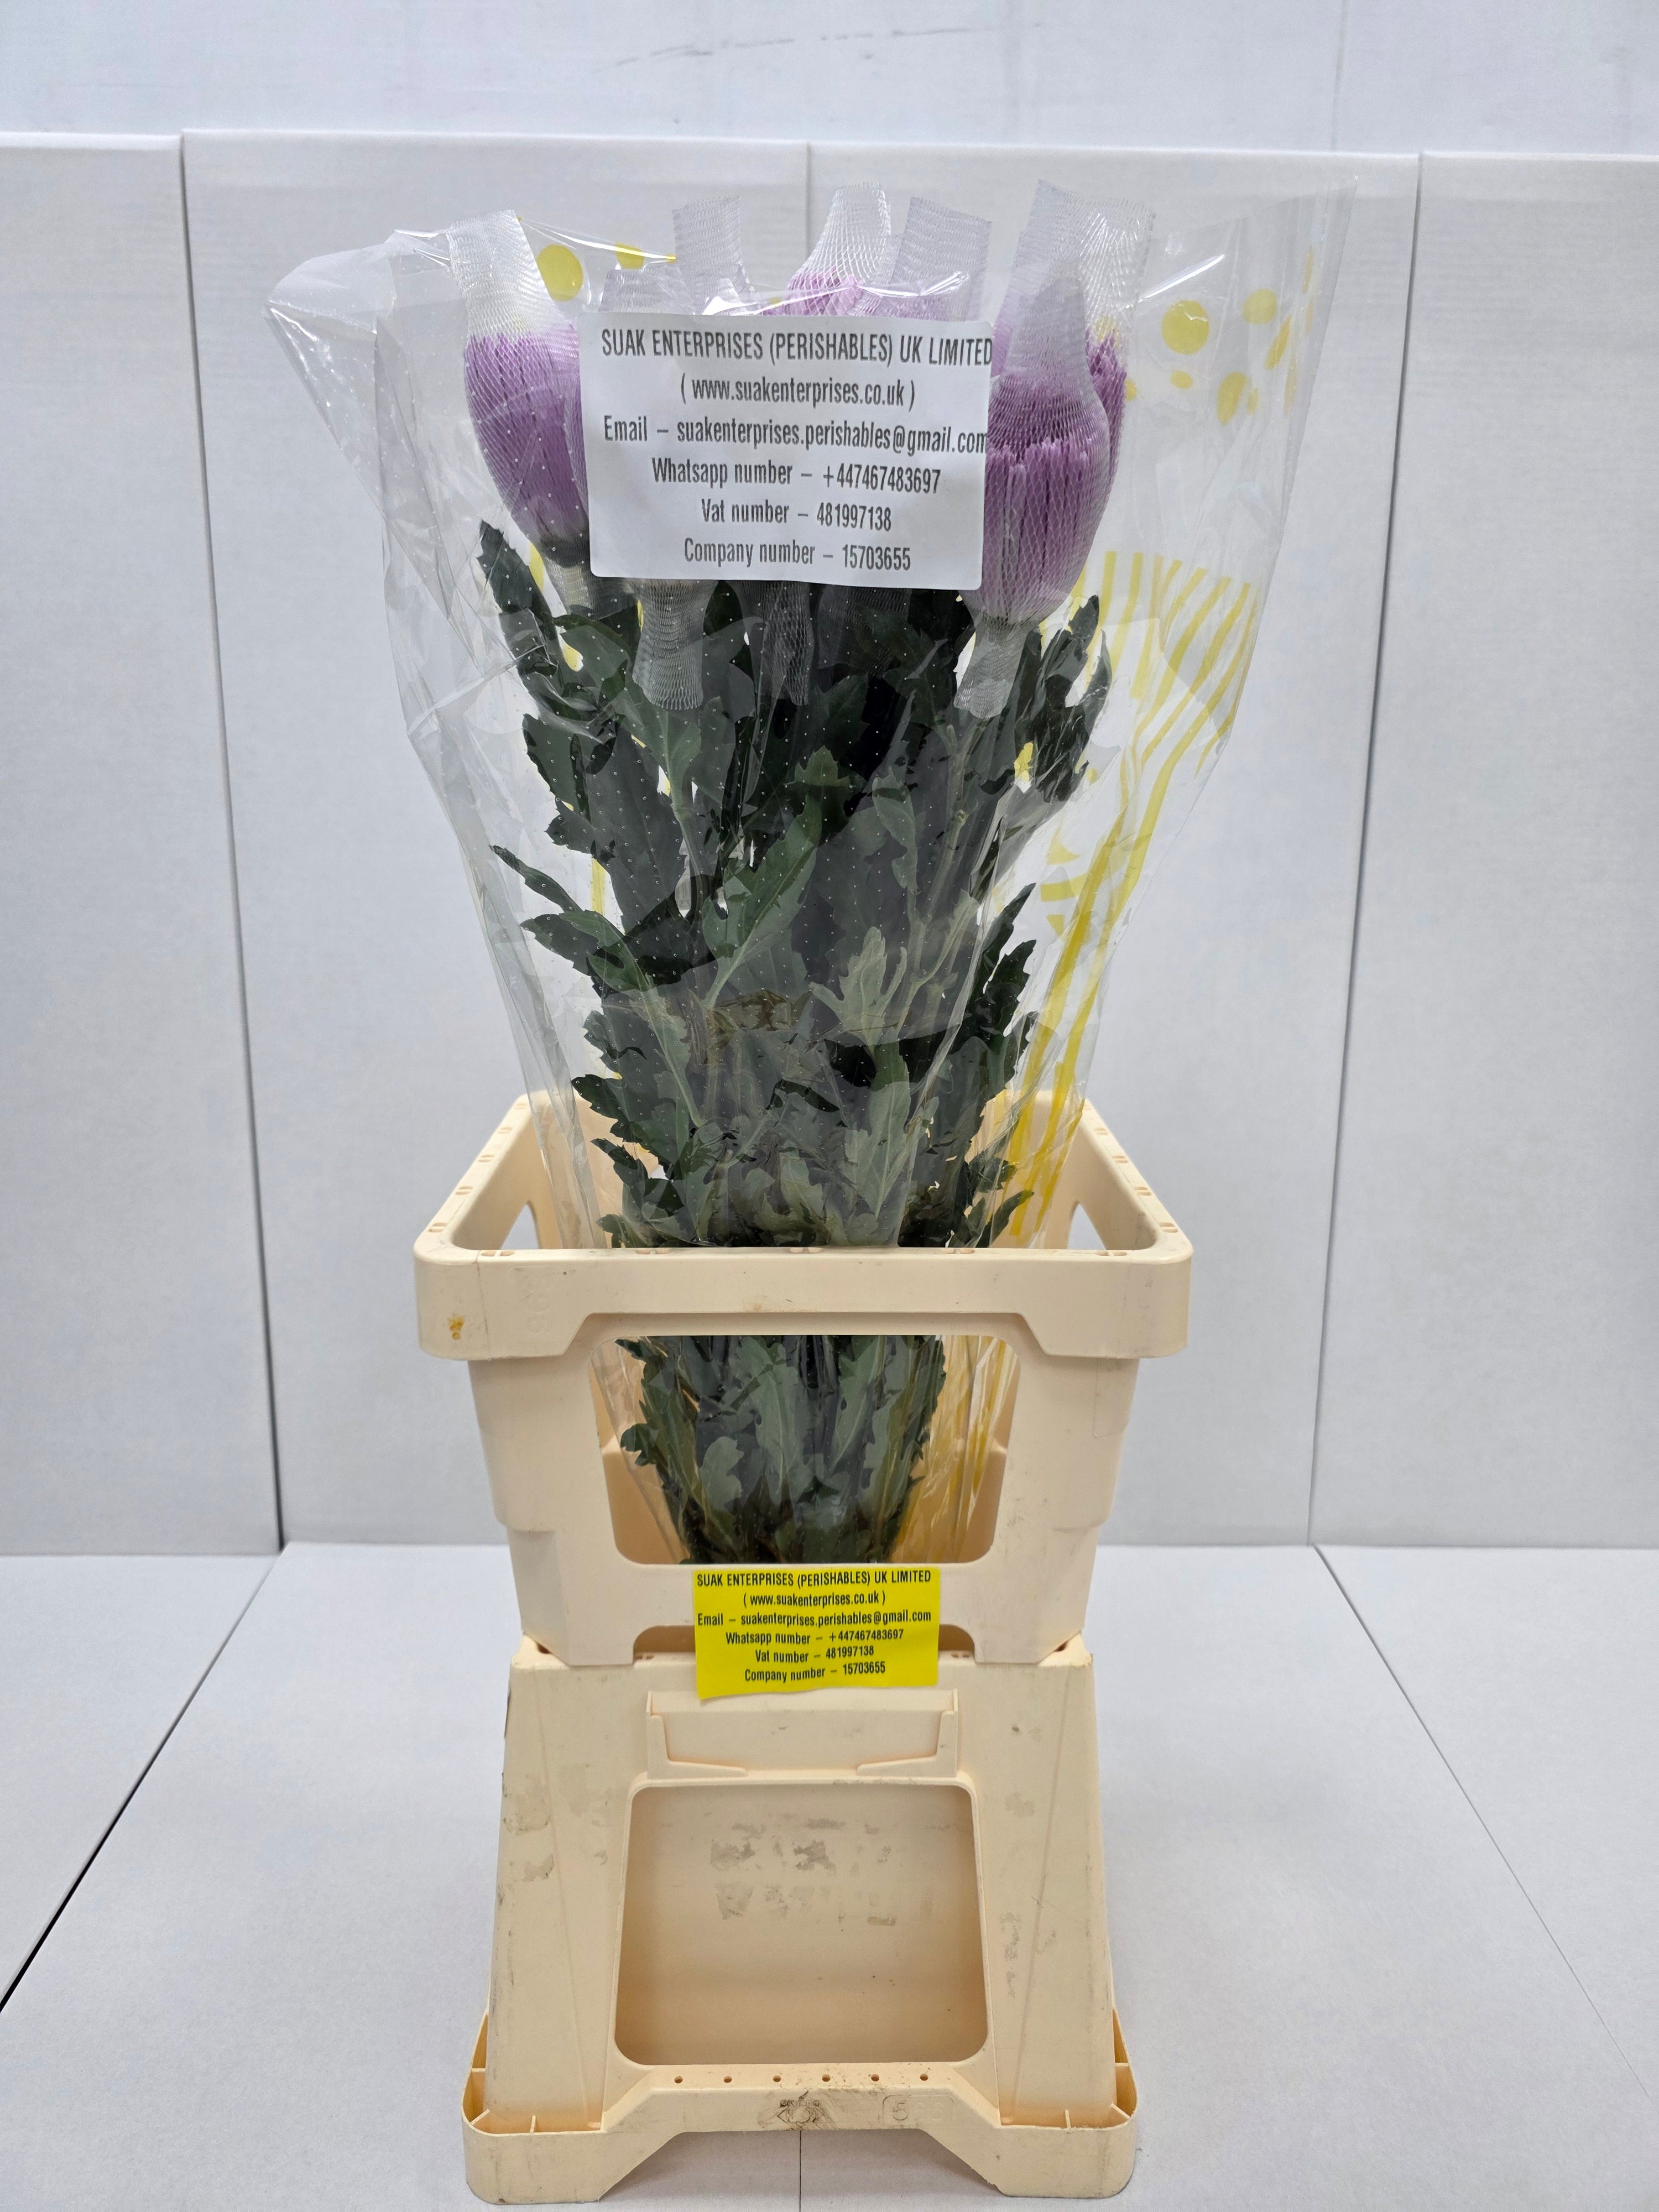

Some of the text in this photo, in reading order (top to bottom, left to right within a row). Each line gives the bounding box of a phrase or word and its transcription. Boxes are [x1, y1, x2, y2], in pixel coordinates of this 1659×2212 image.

[602, 328, 993, 368] SUAK ENTERPRISES (PERISHABLES) UK LIMITED
[604, 415, 648, 442] Email
[677, 416, 988, 457] suakenterprises.perishables@gmail.com
[651, 457, 728, 489] Whatsapp
[734, 459, 793, 484] number
[823, 463, 941, 494] +447467483697
[701, 498, 725, 523] Vat
[732, 499, 789, 524] number
[816, 502, 891, 532] 481997138
[684, 537, 754, 568] Company
[759, 539, 815, 565] number
[842, 544, 911, 571] 15703655
[697, 1570, 931, 1589] SUAK ENTERPRISES (PERISHABLES) UK LIMITED
[697, 1613, 723, 1626] Email
[740, 1609, 931, 1628] suakenterprises.perishables@gmail.com
[726, 1632, 771, 1646] Whatsapp
[775, 1632, 811, 1645] number
[829, 1629, 904, 1642] +447467483697
[755, 1649, 770, 1662] Vat
[773, 1651, 809, 1663] number
[825, 1645, 874, 1659] 481997138
[745, 1669, 787, 1683] Company
[790, 1667, 826, 1681] number
[843, 1661, 885, 1675] 15703655
